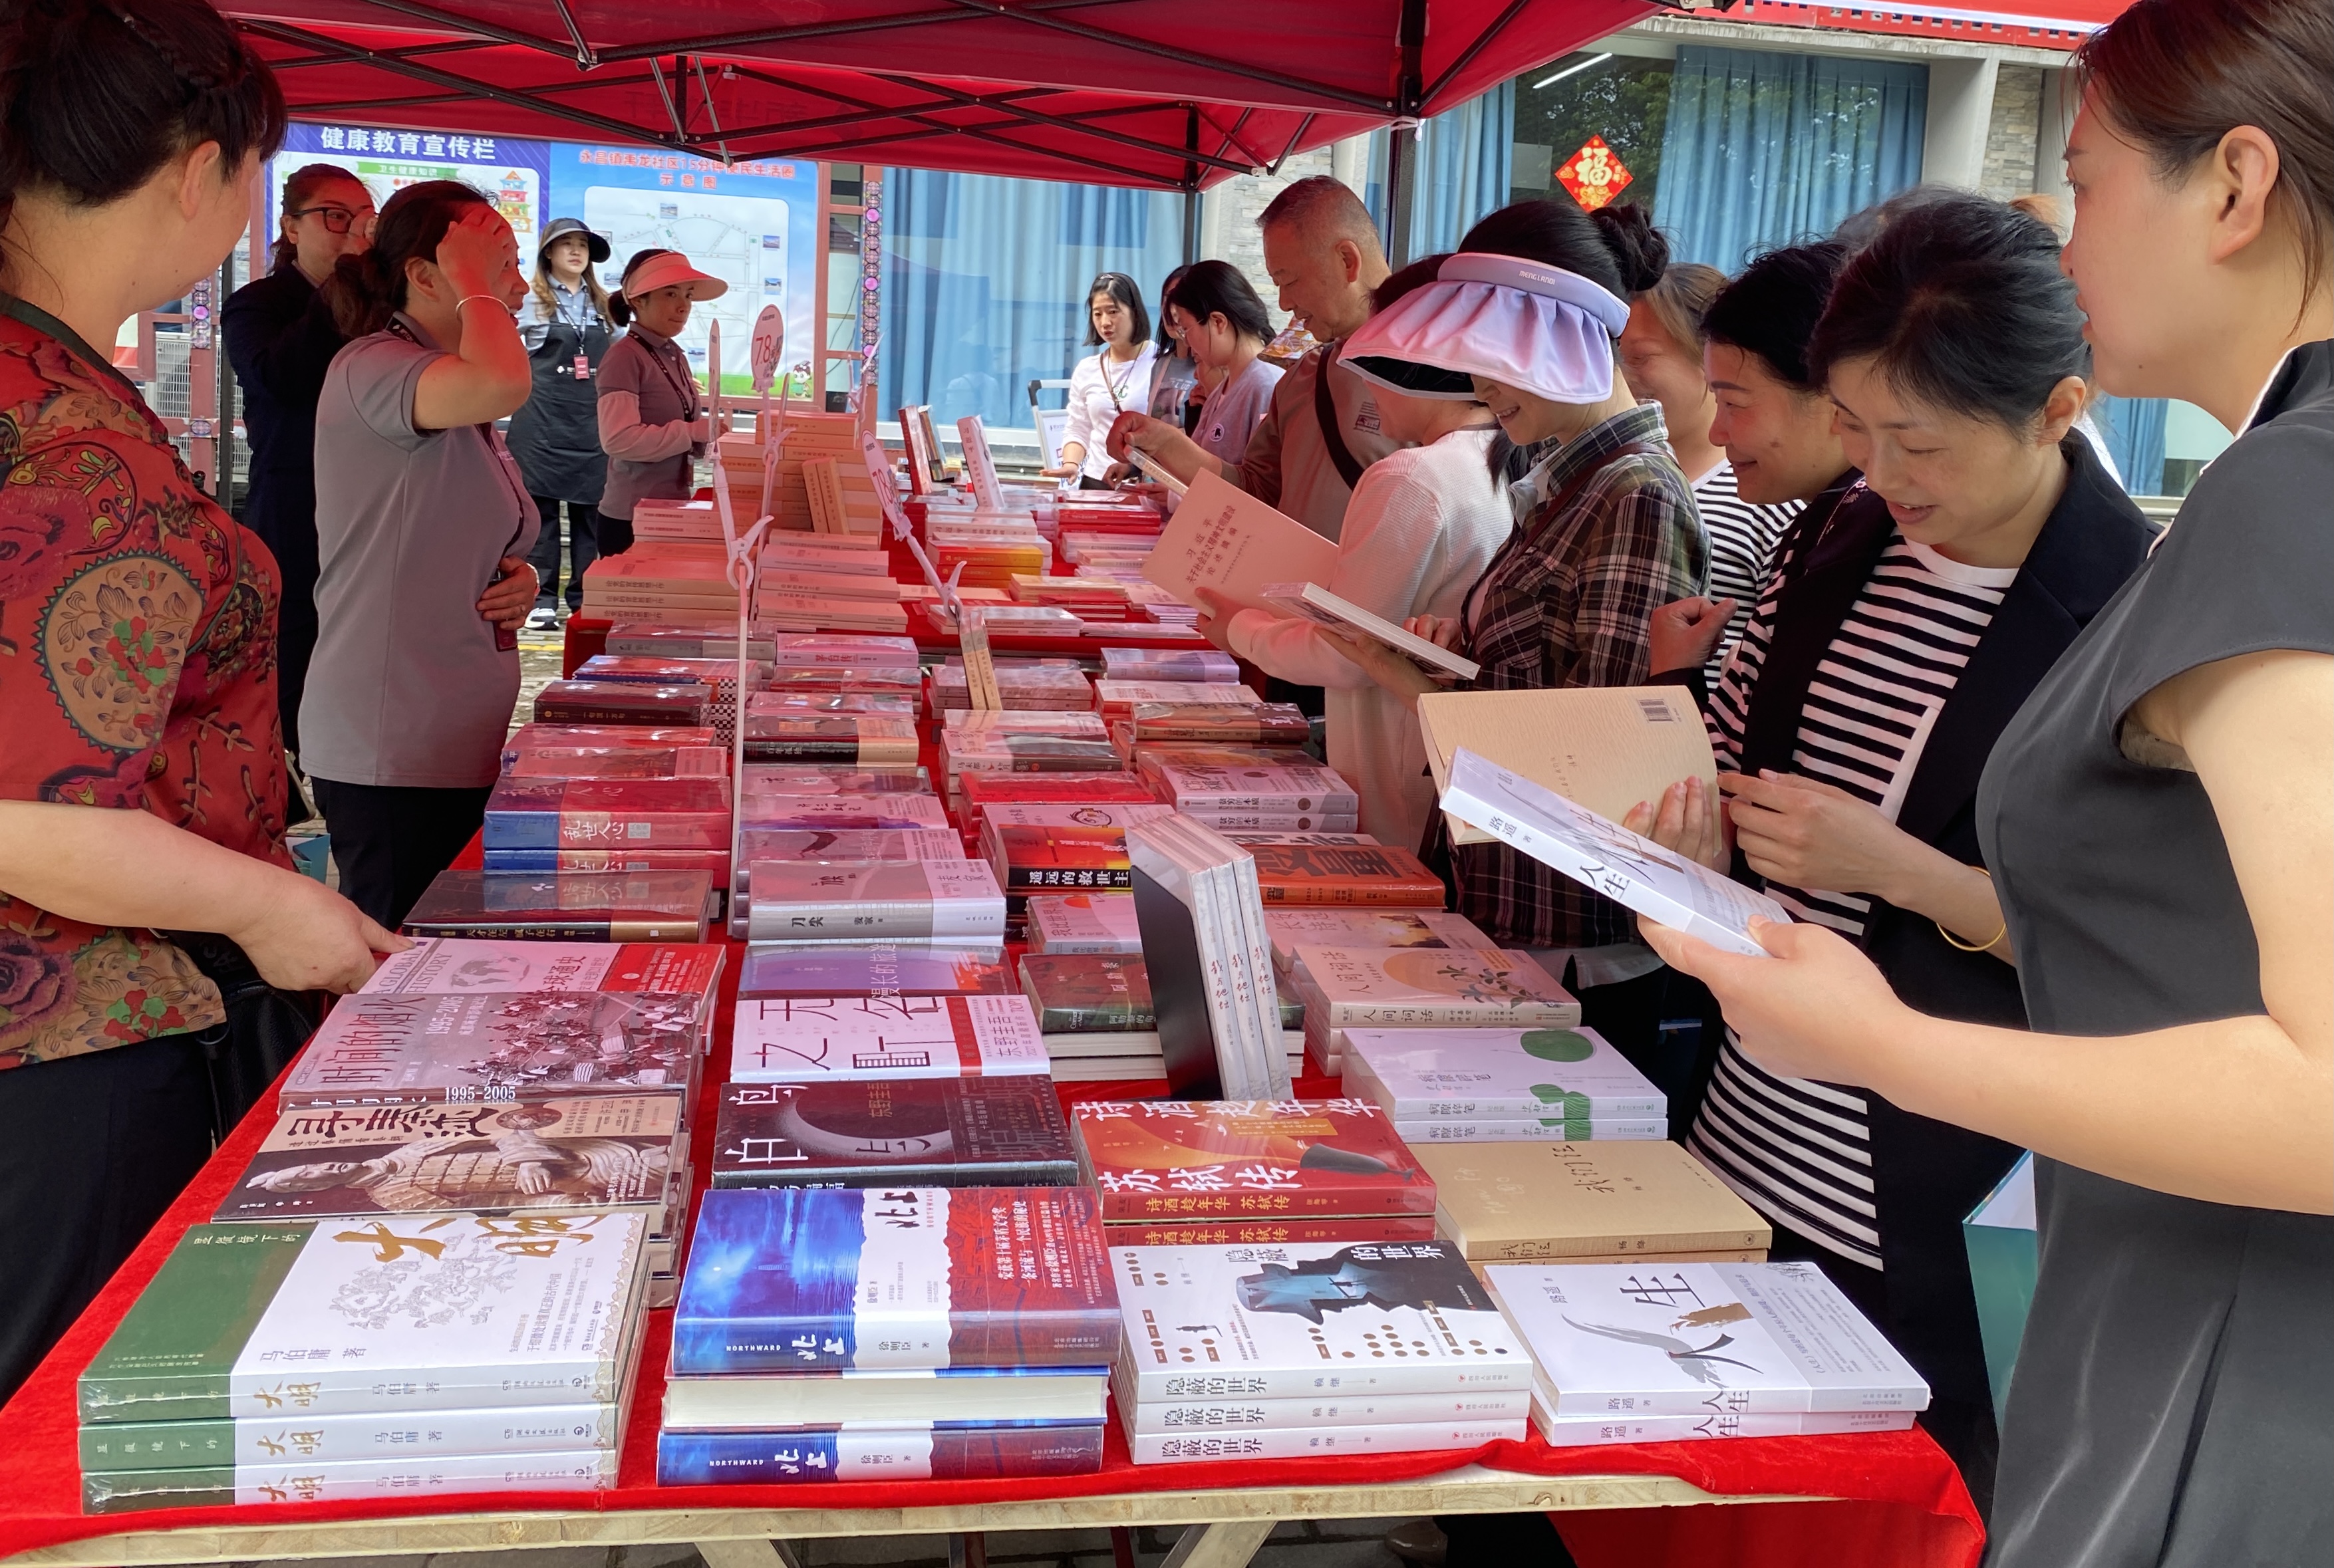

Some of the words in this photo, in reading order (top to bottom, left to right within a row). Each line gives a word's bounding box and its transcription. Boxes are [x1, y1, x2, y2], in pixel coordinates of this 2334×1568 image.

[321, 126, 496, 160] 健康教育宣传栏
[378, 164, 438, 177] 卫生健康知识
[1575, 147, 1613, 186] 福
[660, 173, 717, 190] 示意图
[1185, 505, 1237, 585] 关于社会主义精神文明建设
[1186, 518, 1213, 559] 习近平
[1219, 797, 1260, 806] 贫穷的本质
[563, 820, 625, 841] 乱世人心
[1488, 816, 1518, 838] 路遥
[1578, 864, 1631, 901] 人生
[1029, 870, 1129, 886] 遥远的救世主
[792, 916, 824, 928] 刀尖
[406, 952, 453, 994] HISTORY
[535, 955, 588, 993] 全球通史
[869, 943, 899, 999] 漫长的旅途
[1320, 951, 1374, 995] 人间词话
[426, 995, 466, 1036] 1995-2005
[1109, 1015, 1156, 1025] 阿勒泰的角
[1364, 1009, 1434, 1023] 人间词话
[319, 997, 427, 1085] 时间的烟火
[988, 1014, 1023, 1059] 东野圭吾
[445, 1086, 516, 1101] 1995-2005
[867, 1081, 893, 1119] 东野圭吾
[1429, 1103, 1475, 1115] 病隙碎笔
[1429, 1126, 1476, 1139] 病隙碎笔
[1098, 1164, 1302, 1194] 苏轼传
[1551, 1145, 1615, 1194] 我们仨
[874, 1190, 919, 1230] 北上
[926, 1190, 935, 1229] NORTHWARD
[1145, 1196, 1231, 1214] 诗酒趁年华
[1240, 1194, 1290, 1211] 苏轼传
[194, 1233, 301, 1247] 显微镜下的
[331, 1213, 607, 1263] 大明
[992, 1206, 1016, 1280] 荣获第十届茅盾文学奖
[1011, 1200, 1038, 1288] 一条河流与一个民族的秘史
[1145, 1230, 1230, 1246] 诗酒趁年华
[1239, 1228, 1290, 1243] 苏轼传
[1501, 1241, 1551, 1258] 我们仨
[1618, 1240, 1647, 1250] 杨绛
[259, 1348, 332, 1364] 马伯庸
[343, 1347, 367, 1361] 著
[792, 1333, 845, 1361] 北上
[878, 1341, 913, 1352] 徐则臣
[253, 1380, 323, 1409] 大明
[372, 1381, 417, 1396] 马伯庸
[1166, 1376, 1267, 1396] 隐蔽的世界
[1608, 1398, 1635, 1411] 路遥
[1701, 1390, 1750, 1413] 人生
[1164, 1407, 1266, 1426] 隐蔽的世界
[1600, 1425, 1627, 1439] 路遥
[1692, 1414, 1739, 1438] 人生
[257, 1428, 325, 1457] 大明
[374, 1429, 420, 1445] 马伯庸
[1161, 1438, 1263, 1457] 隐蔽的世界
[774, 1448, 827, 1475] 北上
[861, 1454, 894, 1465] 徐则臣
[257, 1474, 326, 1502] 大明
[375, 1473, 420, 1489] 马伯庸
